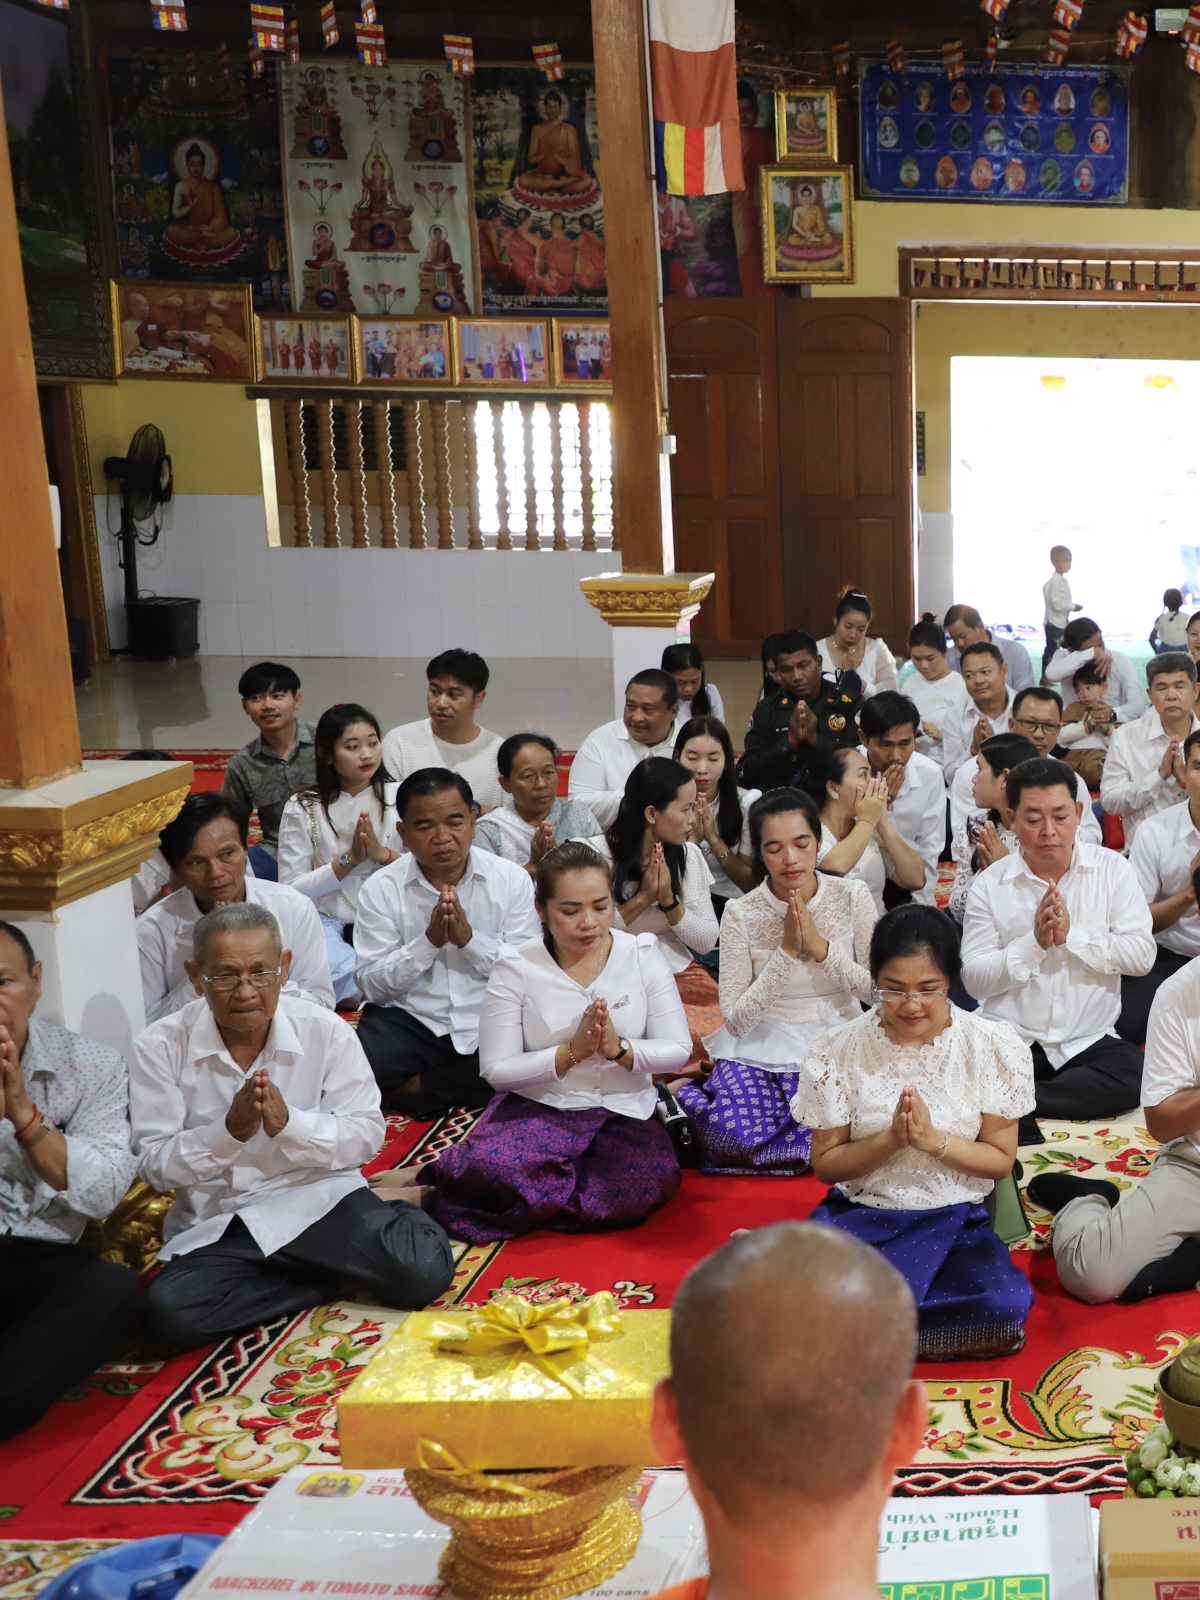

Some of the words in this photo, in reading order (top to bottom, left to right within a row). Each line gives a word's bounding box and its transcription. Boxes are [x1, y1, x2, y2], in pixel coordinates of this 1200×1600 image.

[886, 1513, 937, 1524] With
[944, 1508, 1019, 1523] Handle
[209, 1576, 296, 1592] MACKEREL
[298, 1580, 319, 1593] IN
[323, 1580, 392, 1596] TOMATO
[393, 1583, 448, 1598] SAUCE
[616, 1589, 650, 1597] cans
